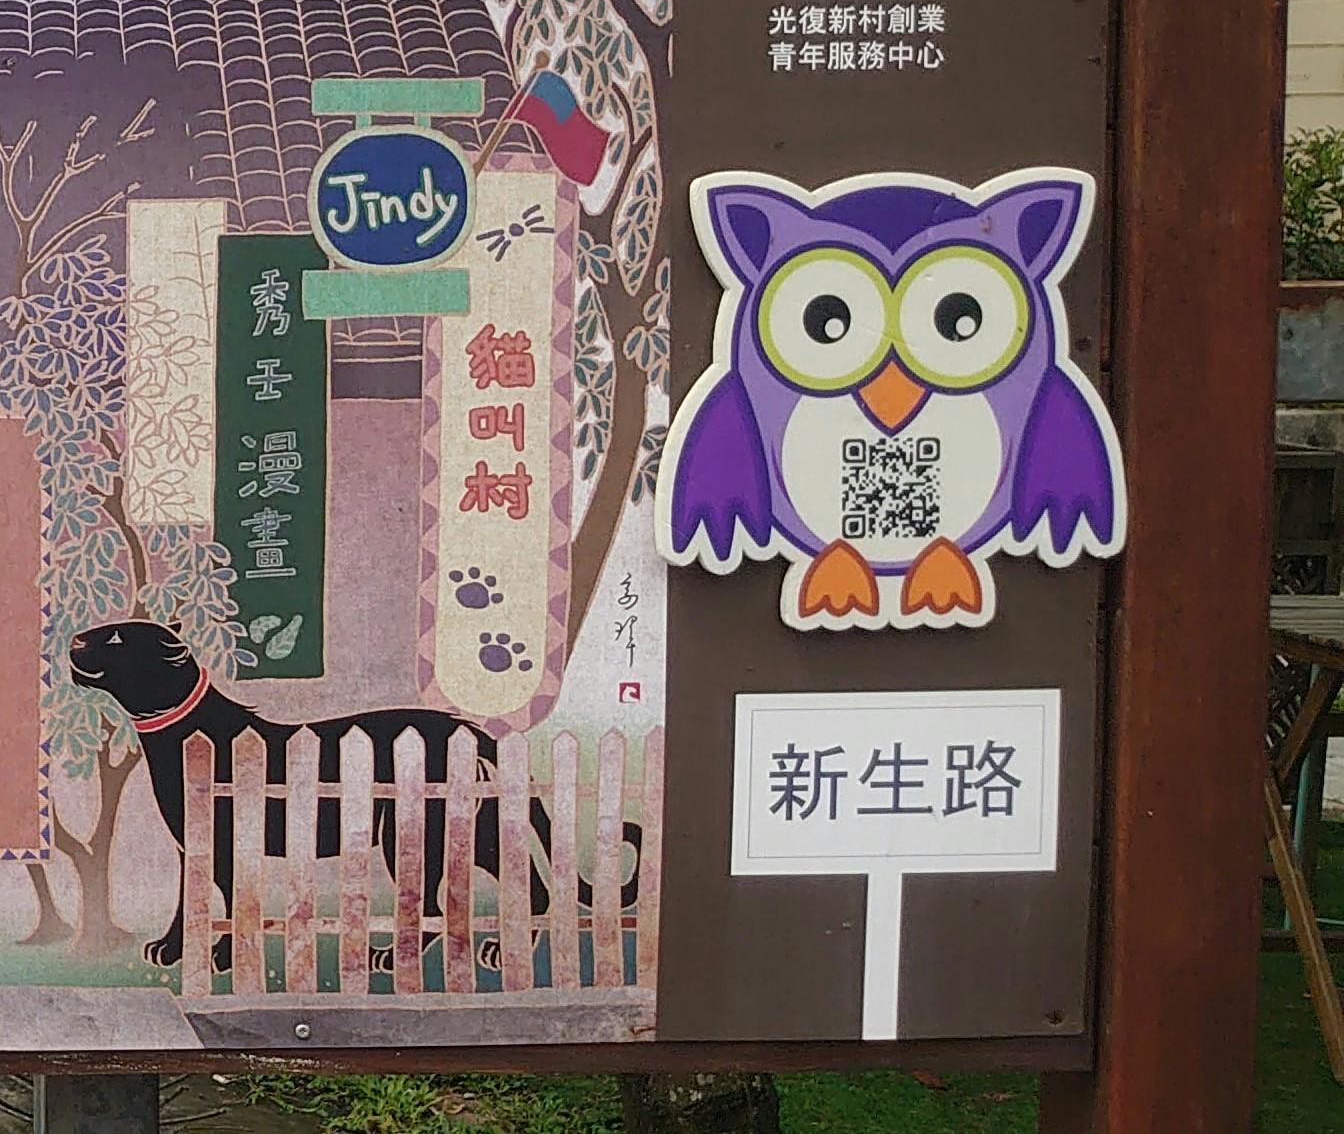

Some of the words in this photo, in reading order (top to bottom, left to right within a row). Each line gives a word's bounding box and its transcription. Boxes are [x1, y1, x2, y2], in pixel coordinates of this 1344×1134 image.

[768, 4, 945, 35] 光復新村創業
[768, 40, 945, 71] 青年服務中心
[324, 167, 458, 246] Jindy
[459, 322, 537, 522] 貓叫村
[768, 739, 1023, 821] 新生路
